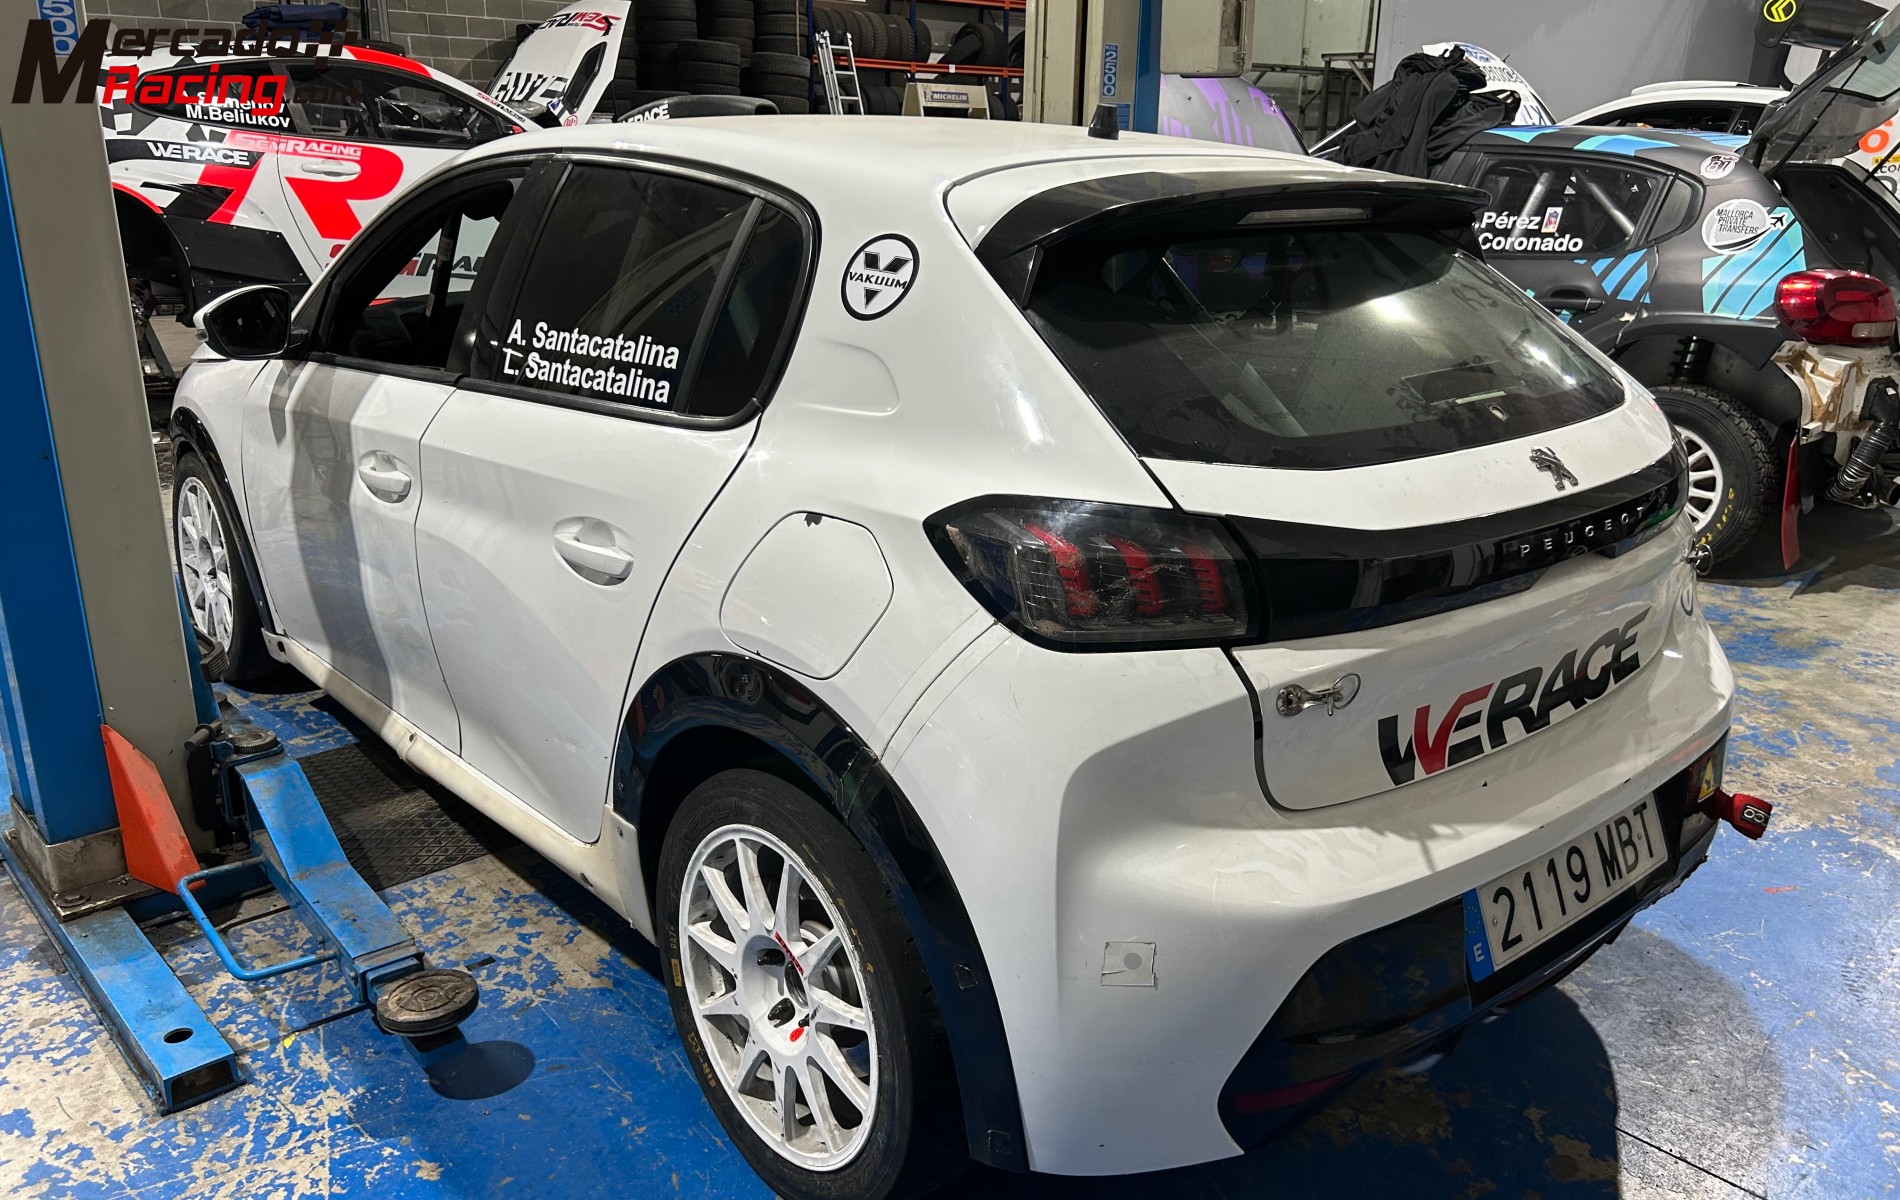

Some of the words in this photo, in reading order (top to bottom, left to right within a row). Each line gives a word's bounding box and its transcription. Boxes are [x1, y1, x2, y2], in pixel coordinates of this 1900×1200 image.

[1103, 50, 1117, 96] 2500
[932, 93, 968, 101] MICHELIN
[186, 103, 290, 128] M.Beliukov
[147, 141, 250, 166] WERACE
[1716, 208, 1753, 219] MALLORCA
[1718, 216, 1747, 226] PRIVATE
[1719, 223, 1759, 234] TRANSFERS
[1478, 232, 1583, 252] Coronado
[849, 271, 908, 289] VAKUUM
[507, 318, 526, 346] A.
[532, 321, 680, 369] Santacatalina
[525, 351, 671, 404] Santacatalina
[1519, 506, 1645, 558] PEUGEOT
[1377, 606, 1651, 787] WERACE
[1492, 845, 1591, 953] 2119
[1593, 801, 1655, 889] MBT
[1473, 941, 1485, 963] E
